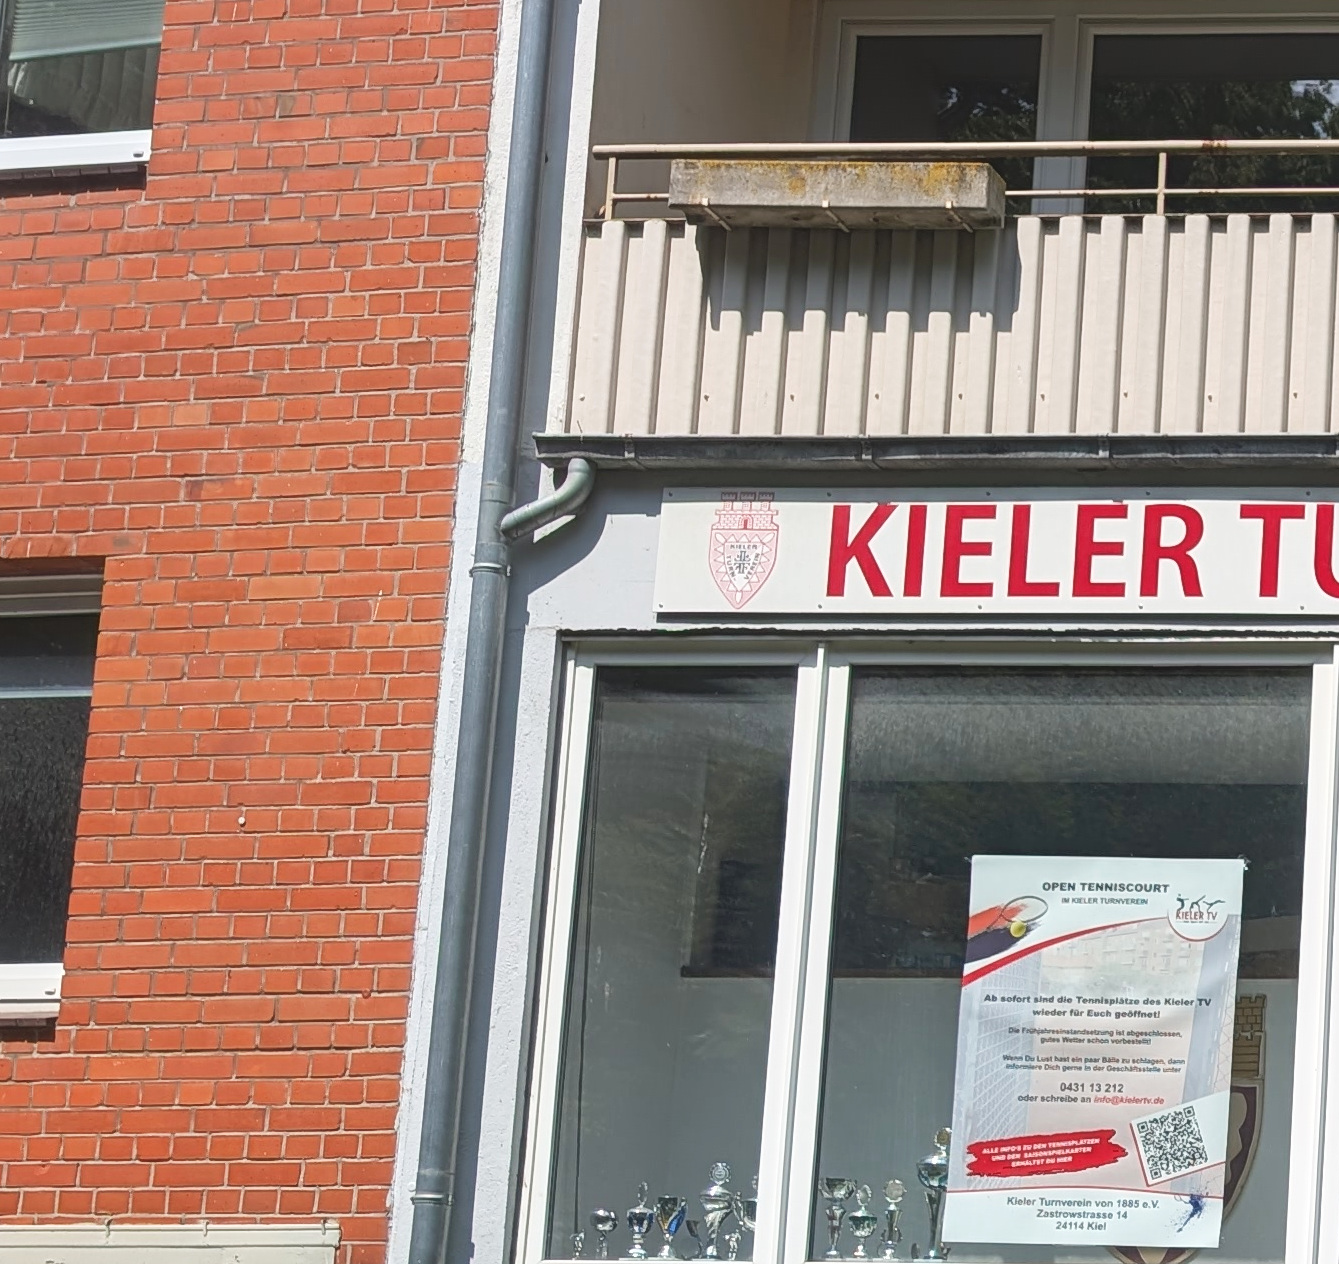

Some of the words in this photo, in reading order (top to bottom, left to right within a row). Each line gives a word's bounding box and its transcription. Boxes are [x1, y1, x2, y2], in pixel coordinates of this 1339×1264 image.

[826, 502, 1204, 597] KIELER
[1042, 882, 1076, 892] OPEN
[1080, 882, 1170, 893] TENNISCOURT
[1071, 897, 1099, 905] KIELER
[1100, 897, 1148, 905] TURNVEREIN
[1176, 911, 1204, 920] KIELER
[1207, 911, 1218, 920] TV
[983, 994, 998, 1002] Ab
[1000, 995, 1031, 1003] sofort
[1076, 996, 1140, 1006] Tennisplätze
[1142, 998, 1161, 1006] des
[1164, 998, 1194, 1006] Kieler
[1197, 998, 1212, 1006] TV
[1033, 1008, 1067, 1016] wieder
[1070, 1009, 1084, 1017] für
[1086, 1009, 1112, 1017] Euch
[1114, 1010, 1160, 1019] geöffnet!
[1060, 1082, 1085, 1092] 0431
[1090, 1083, 1101, 1092] 13
[1104, 1083, 1124, 1093] 212
[1017, 1094, 1038, 1102] oder
[1040, 1095, 1078, 1103] schreibe
[1007, 1197, 1036, 1206] Kieler
[1039, 1197, 1092, 1207] Turnverein
[1095, 1200, 1113, 1208] von
[1117, 1199, 1139, 1208] 1885
[1142, 1200, 1160, 1209] e.V.
[1037, 1209, 1113, 1219] Zastrowstrasse
[1117, 1211, 1128, 1219] 14
[1056, 1221, 1084, 1230] 24114
[1087, 1221, 1107, 1230] Kiel
